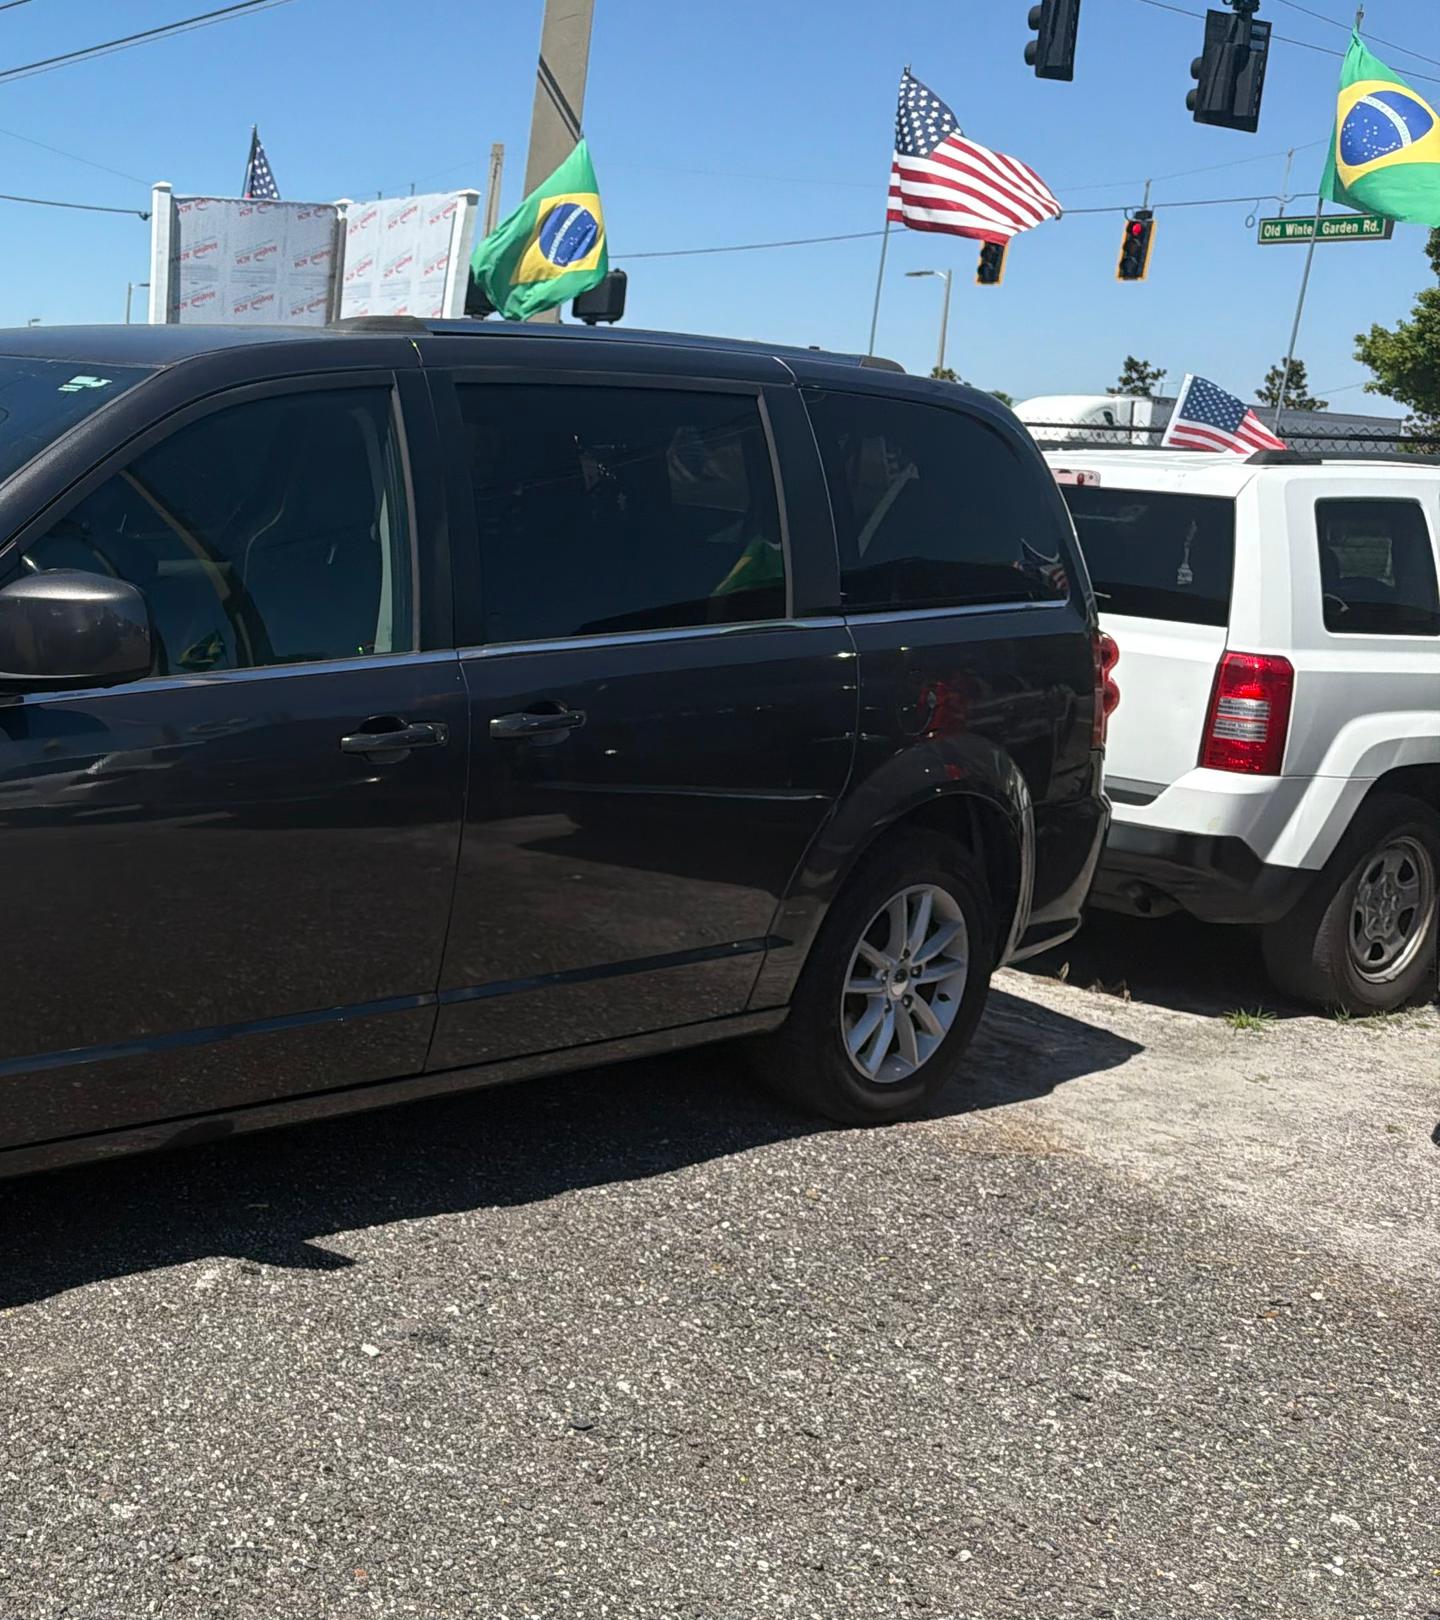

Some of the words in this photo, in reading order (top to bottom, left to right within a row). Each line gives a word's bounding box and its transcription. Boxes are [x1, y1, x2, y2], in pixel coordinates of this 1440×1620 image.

[1264, 225, 1280, 237] Old
[1285, 223, 1313, 236] Winte
[1322, 221, 1358, 234] Garden
[1363, 219, 1380, 232] Rd.
